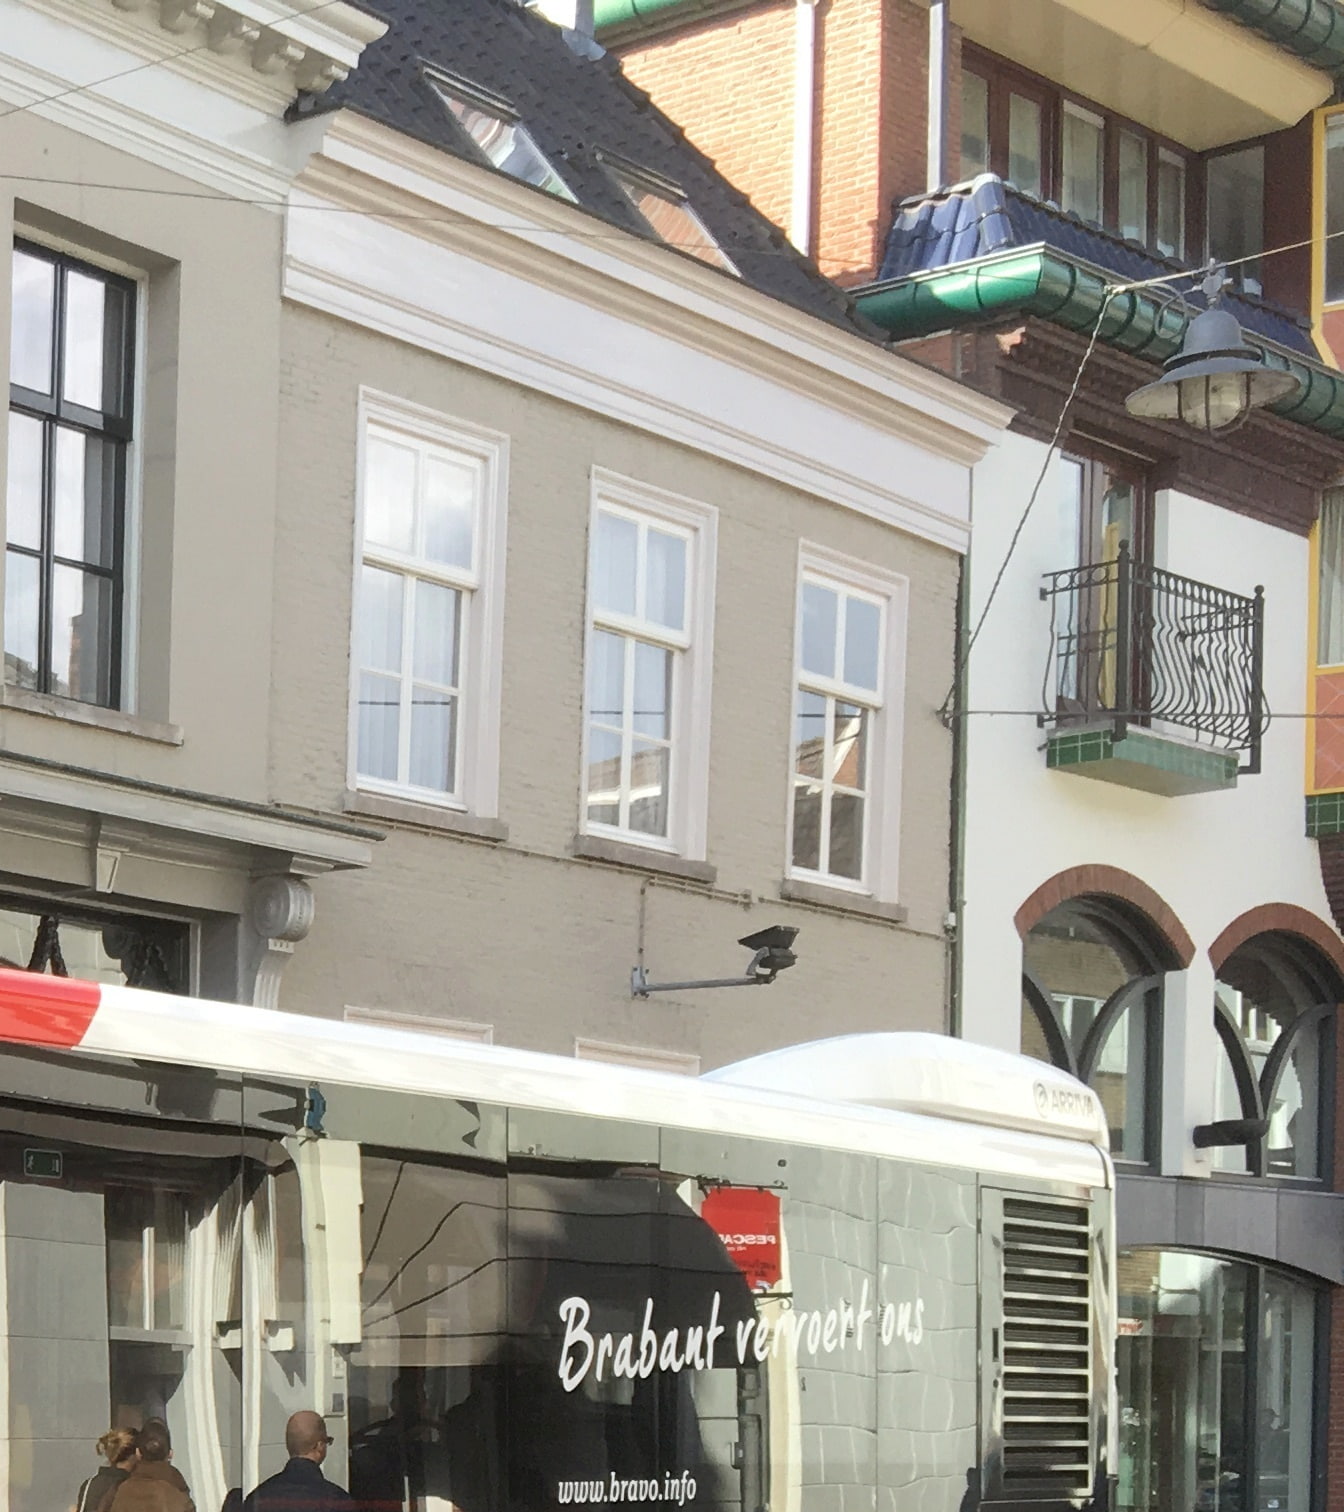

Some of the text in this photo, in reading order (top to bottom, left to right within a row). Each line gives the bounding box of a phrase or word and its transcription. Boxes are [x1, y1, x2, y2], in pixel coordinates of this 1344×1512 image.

[558, 1278, 925, 1393] Brabant vervoert ons
[558, 1470, 698, 1506] www.bravo.info
